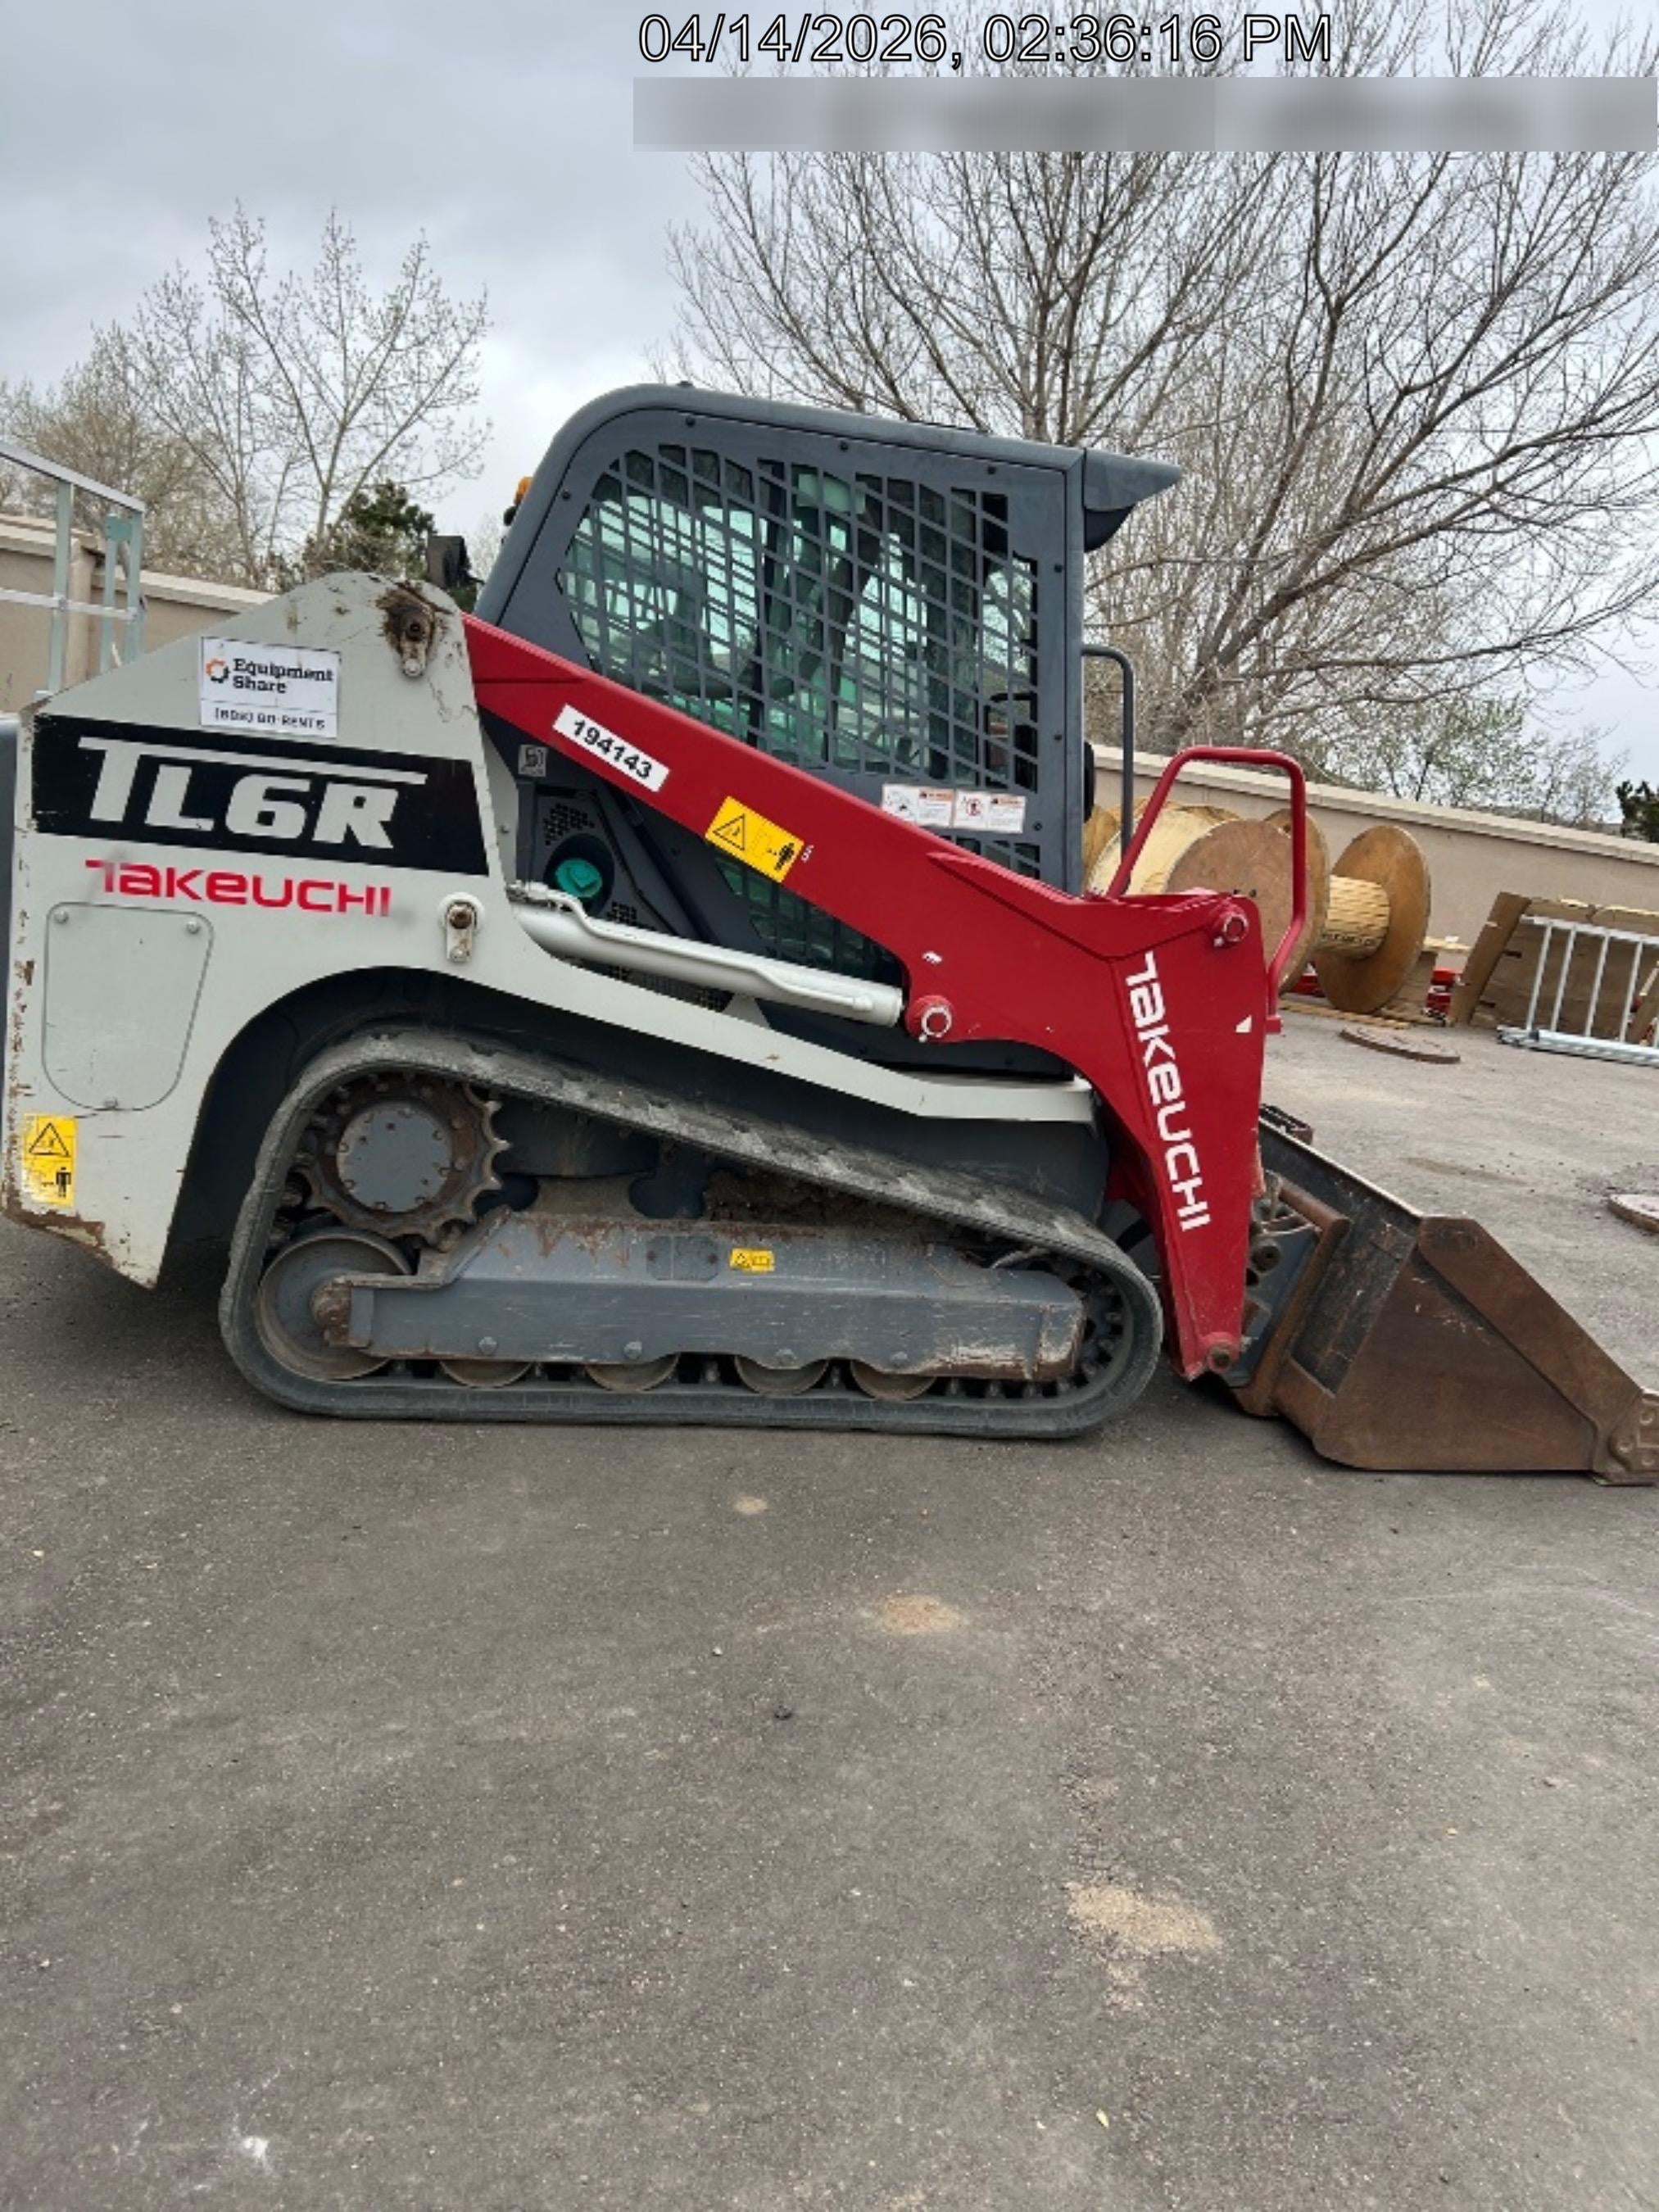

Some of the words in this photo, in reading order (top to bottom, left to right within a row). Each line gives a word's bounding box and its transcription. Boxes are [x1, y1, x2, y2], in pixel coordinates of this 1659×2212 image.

[233, 658, 333, 682] Equipment
[233, 675, 287, 694] Share
[574, 720, 652, 779] 194143
[78, 736, 428, 850] TL6R
